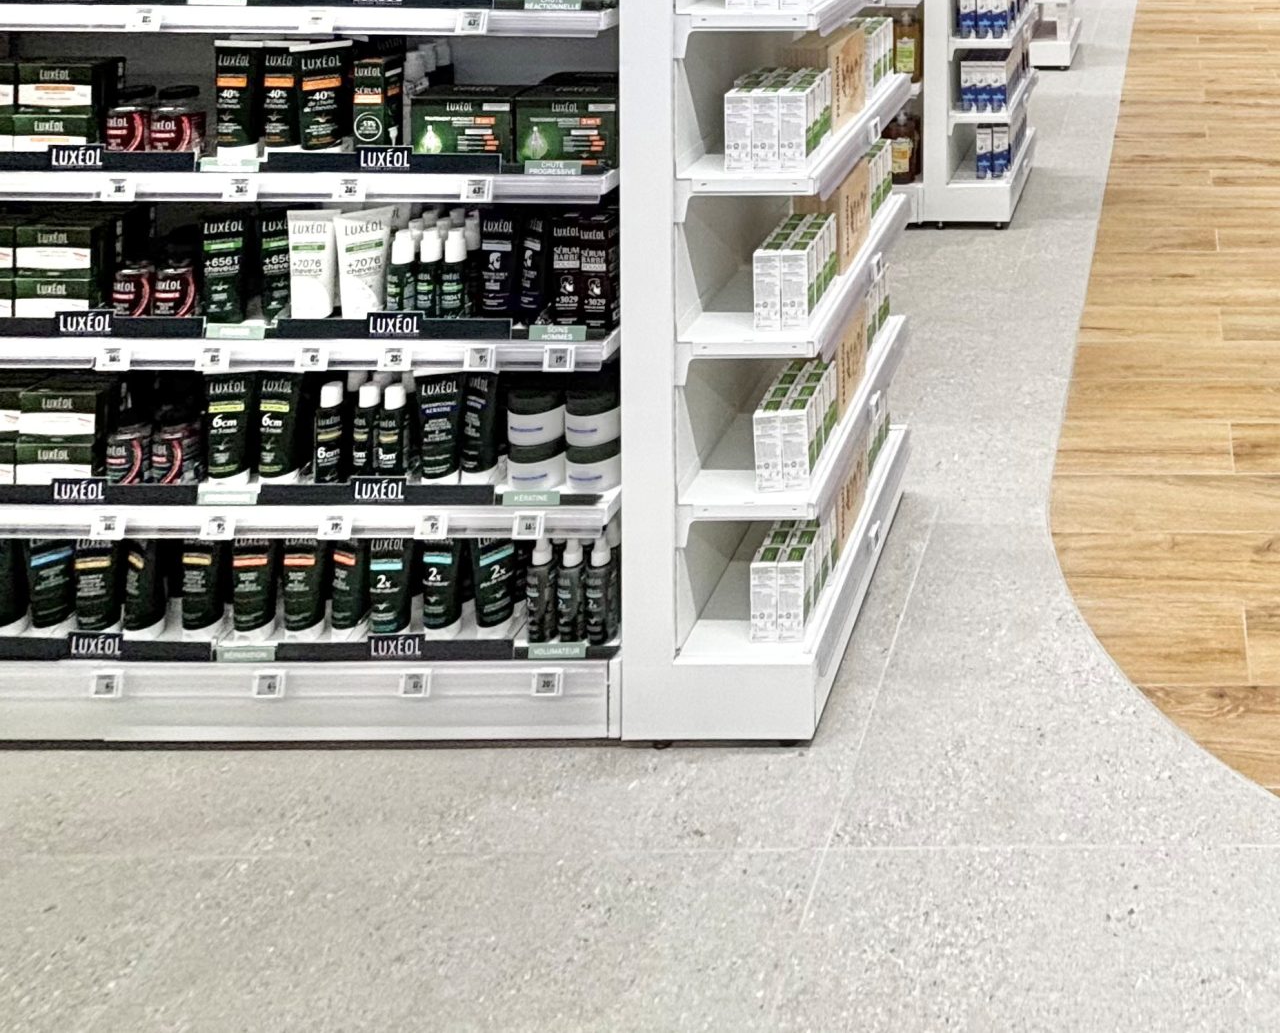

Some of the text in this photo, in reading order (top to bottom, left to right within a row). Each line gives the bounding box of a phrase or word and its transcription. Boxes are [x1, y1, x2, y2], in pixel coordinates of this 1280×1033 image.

[217, 53, 250, 67] LUXÉOL
[301, 55, 342, 70] LUXÉOL
[354, 66, 381, 77] LUXÉOL
[446, 102, 472, 112] LUXÉOL
[34, 120, 64, 132] LUXÉOL
[51, 147, 103, 166] LUXÉOL
[360, 148, 410, 167] LUXÉOL
[204, 220, 244, 235] LUXÉOL
[292, 222, 328, 235] LUXÉOL
[344, 220, 384, 236] LUXÉOL
[483, 219, 513, 233] LUXÉOL
[553, 226, 580, 237] LUXÉOL
[36, 282, 67, 295] LUXÉOL
[59, 312, 112, 332] LUXÉOL
[369, 313, 420, 333] LUXÉOL
[209, 380, 247, 394] LUXÉOL
[262, 379, 292, 393] LUXÉOL
[421, 380, 458, 396] LUXÉOL
[42, 397, 73, 409] LUXÉOL
[212, 414, 238, 428] 6cm
[262, 413, 283, 427] 6cm
[37, 448, 69, 461] LUXÉOL
[317, 446, 340, 459] 6cm
[54, 479, 105, 499] LUXÉOL
[354, 479, 404, 499] LUXÉOL
[377, 575, 392, 589] 2x
[71, 635, 122, 654] LUXÉOL
[370, 637, 422, 656] LUXÉOL
